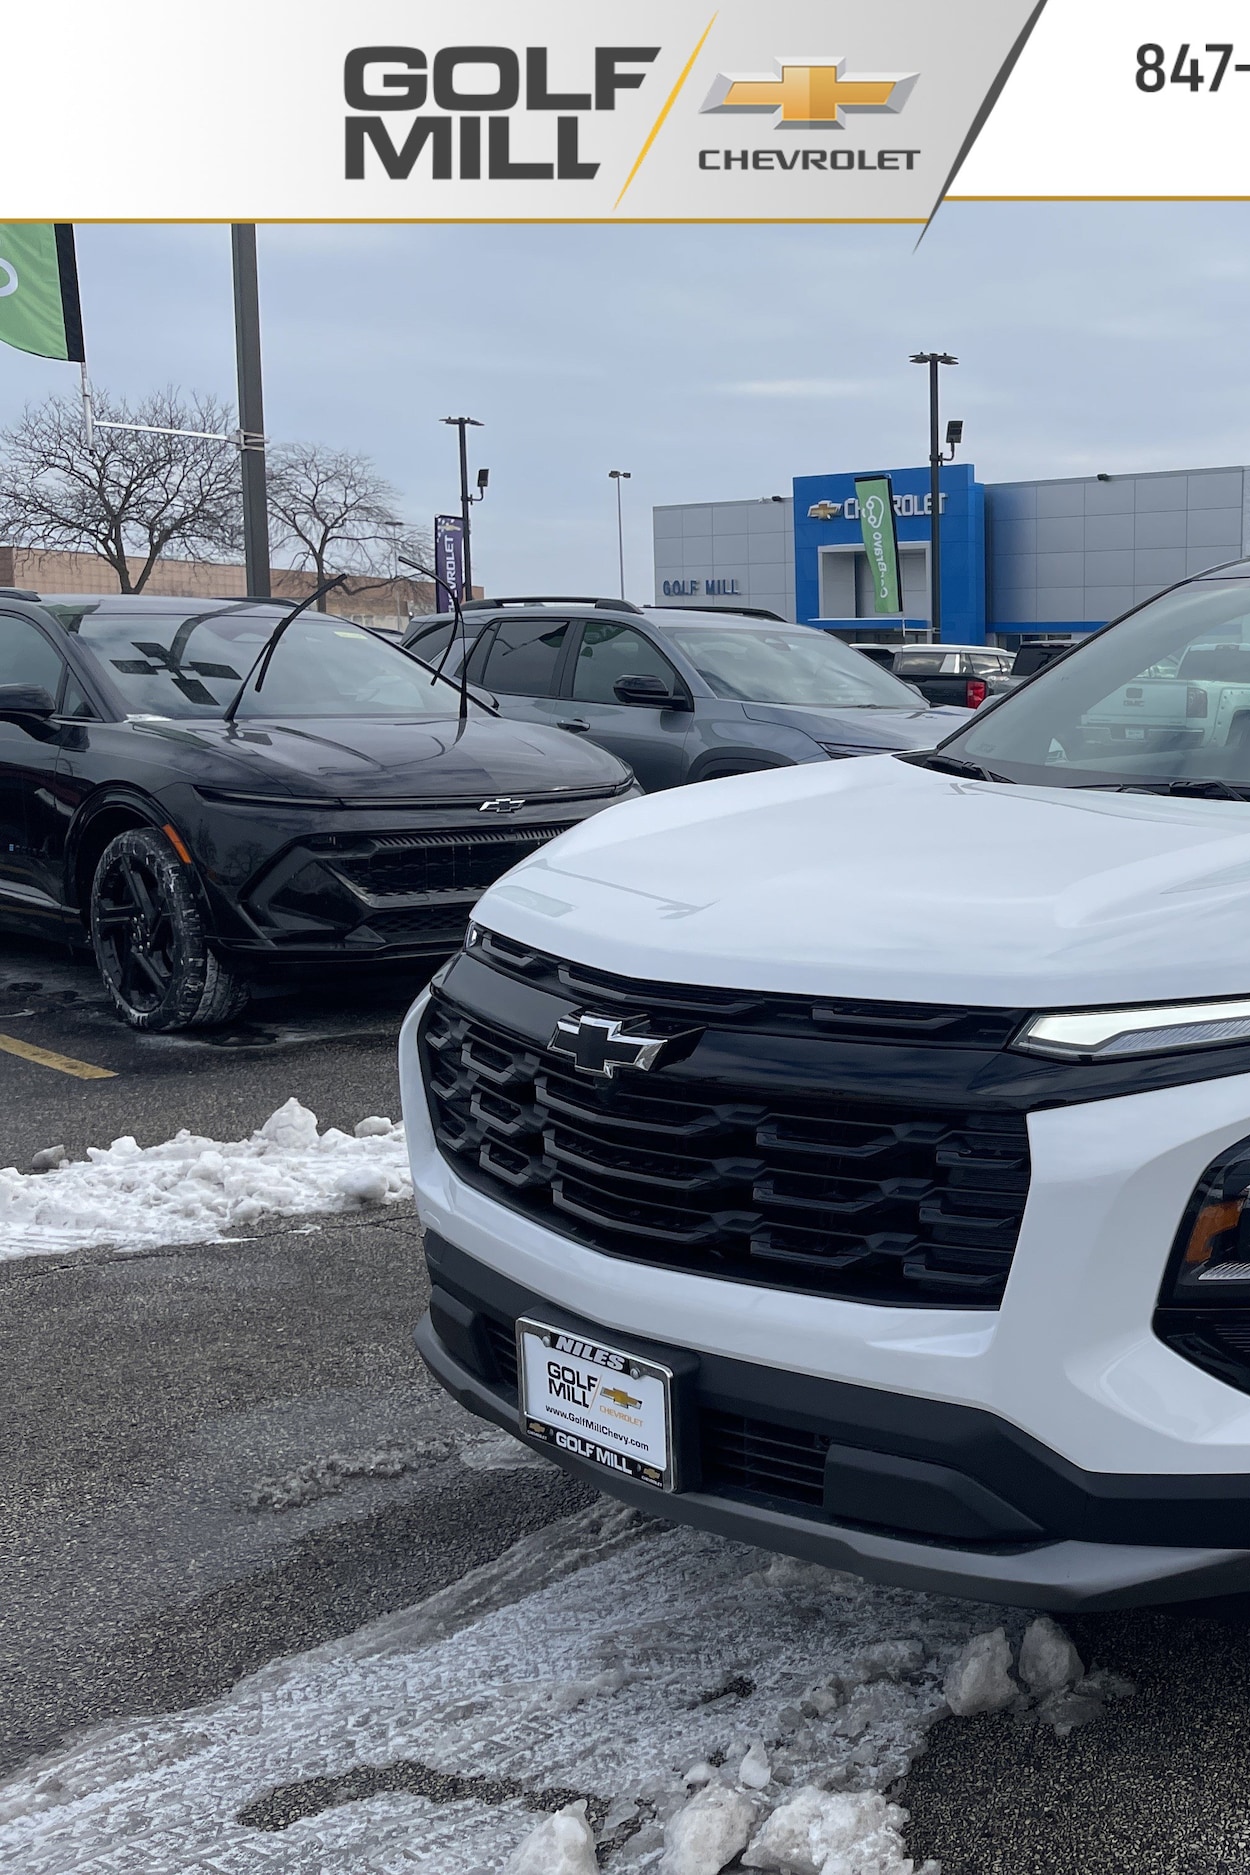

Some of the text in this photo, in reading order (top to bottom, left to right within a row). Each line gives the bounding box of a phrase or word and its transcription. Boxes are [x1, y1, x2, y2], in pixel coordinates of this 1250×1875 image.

[844, 492, 946, 519] CHROLET
[663, 579, 740, 596] GOLF MILL
[556, 1335, 625, 1372] NILES
[547, 1361, 598, 1392] GOLF
[548, 1377, 590, 1409] MILL
[545, 1404, 649, 1452] www.GolfMillChevy.com
[599, 1405, 644, 1428] CHEVROLET
[555, 1431, 633, 1475] GOLF MILL
